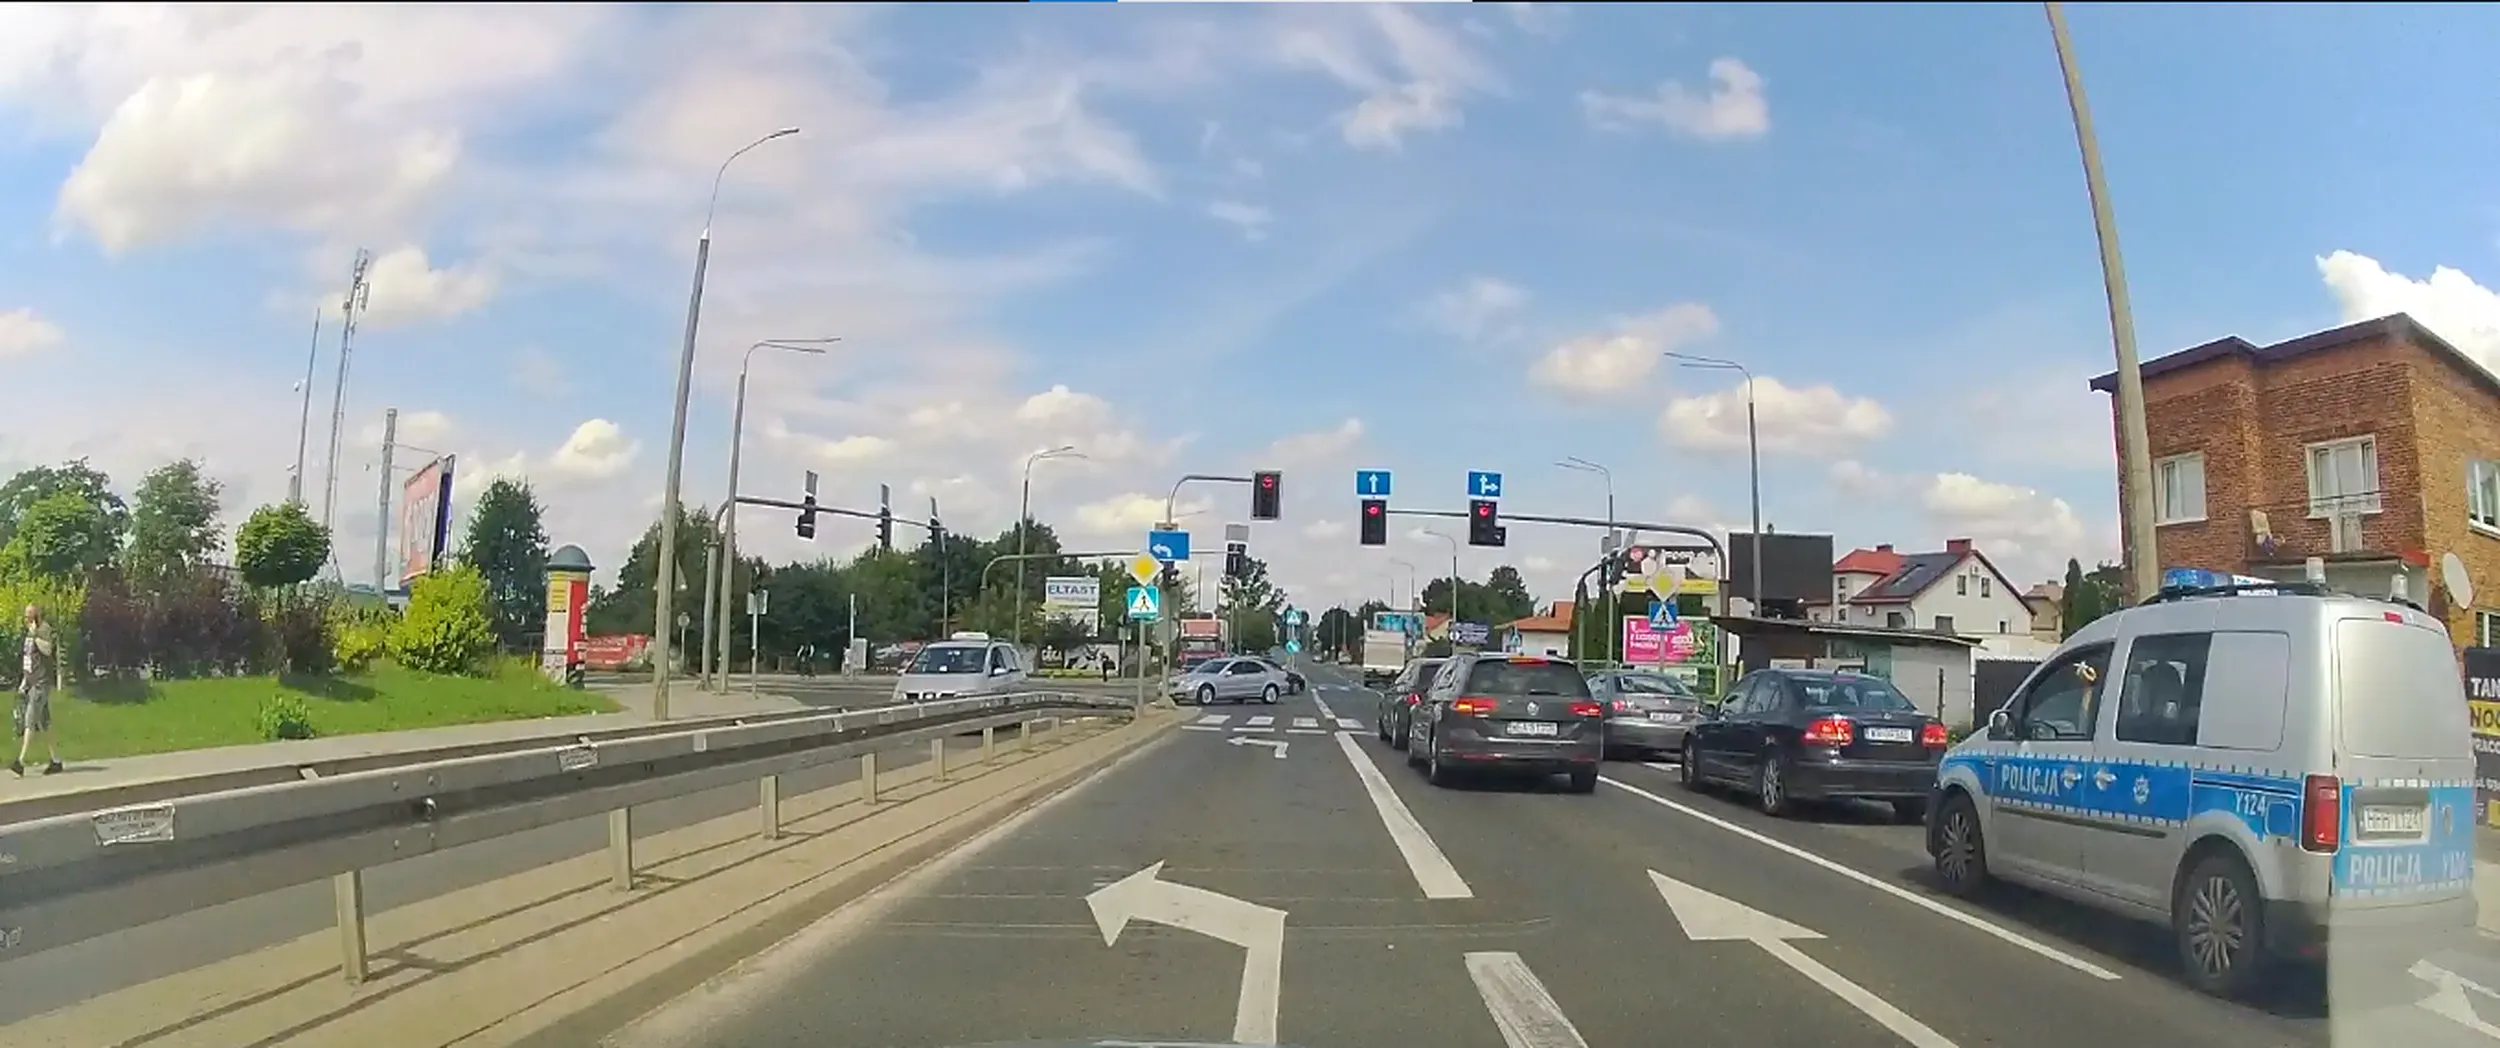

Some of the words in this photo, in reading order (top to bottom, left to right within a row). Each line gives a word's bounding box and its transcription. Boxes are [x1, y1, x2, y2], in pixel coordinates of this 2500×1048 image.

[1048, 585, 1096, 595] ELTAST
[2001, 764, 2059, 797] POLICJA
[2235, 791, 2266, 817] Y124
[2350, 853, 2421, 885] POLICJA
